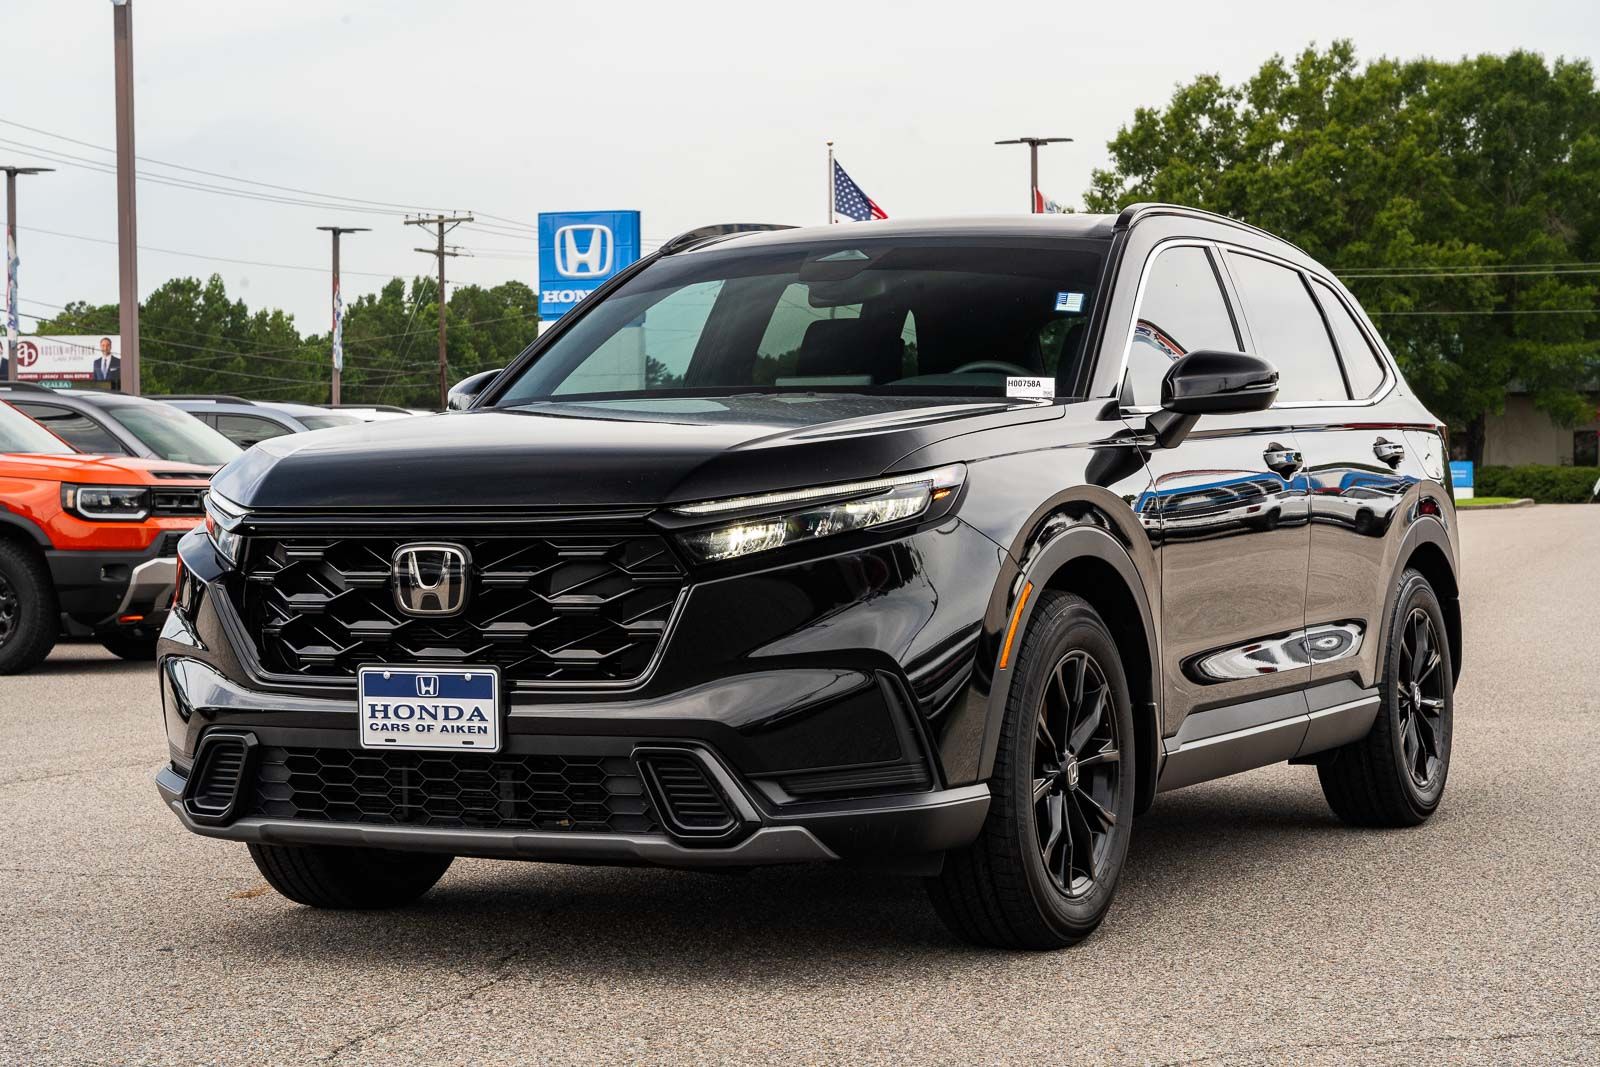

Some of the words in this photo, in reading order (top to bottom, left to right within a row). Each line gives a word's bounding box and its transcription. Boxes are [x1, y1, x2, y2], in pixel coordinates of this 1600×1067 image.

[542, 290, 594, 303] HON
[368, 703, 489, 722] HONDA
[369, 722, 411, 732] CARS
[415, 724, 436, 733] OF
[440, 724, 489, 734] AIKEN
